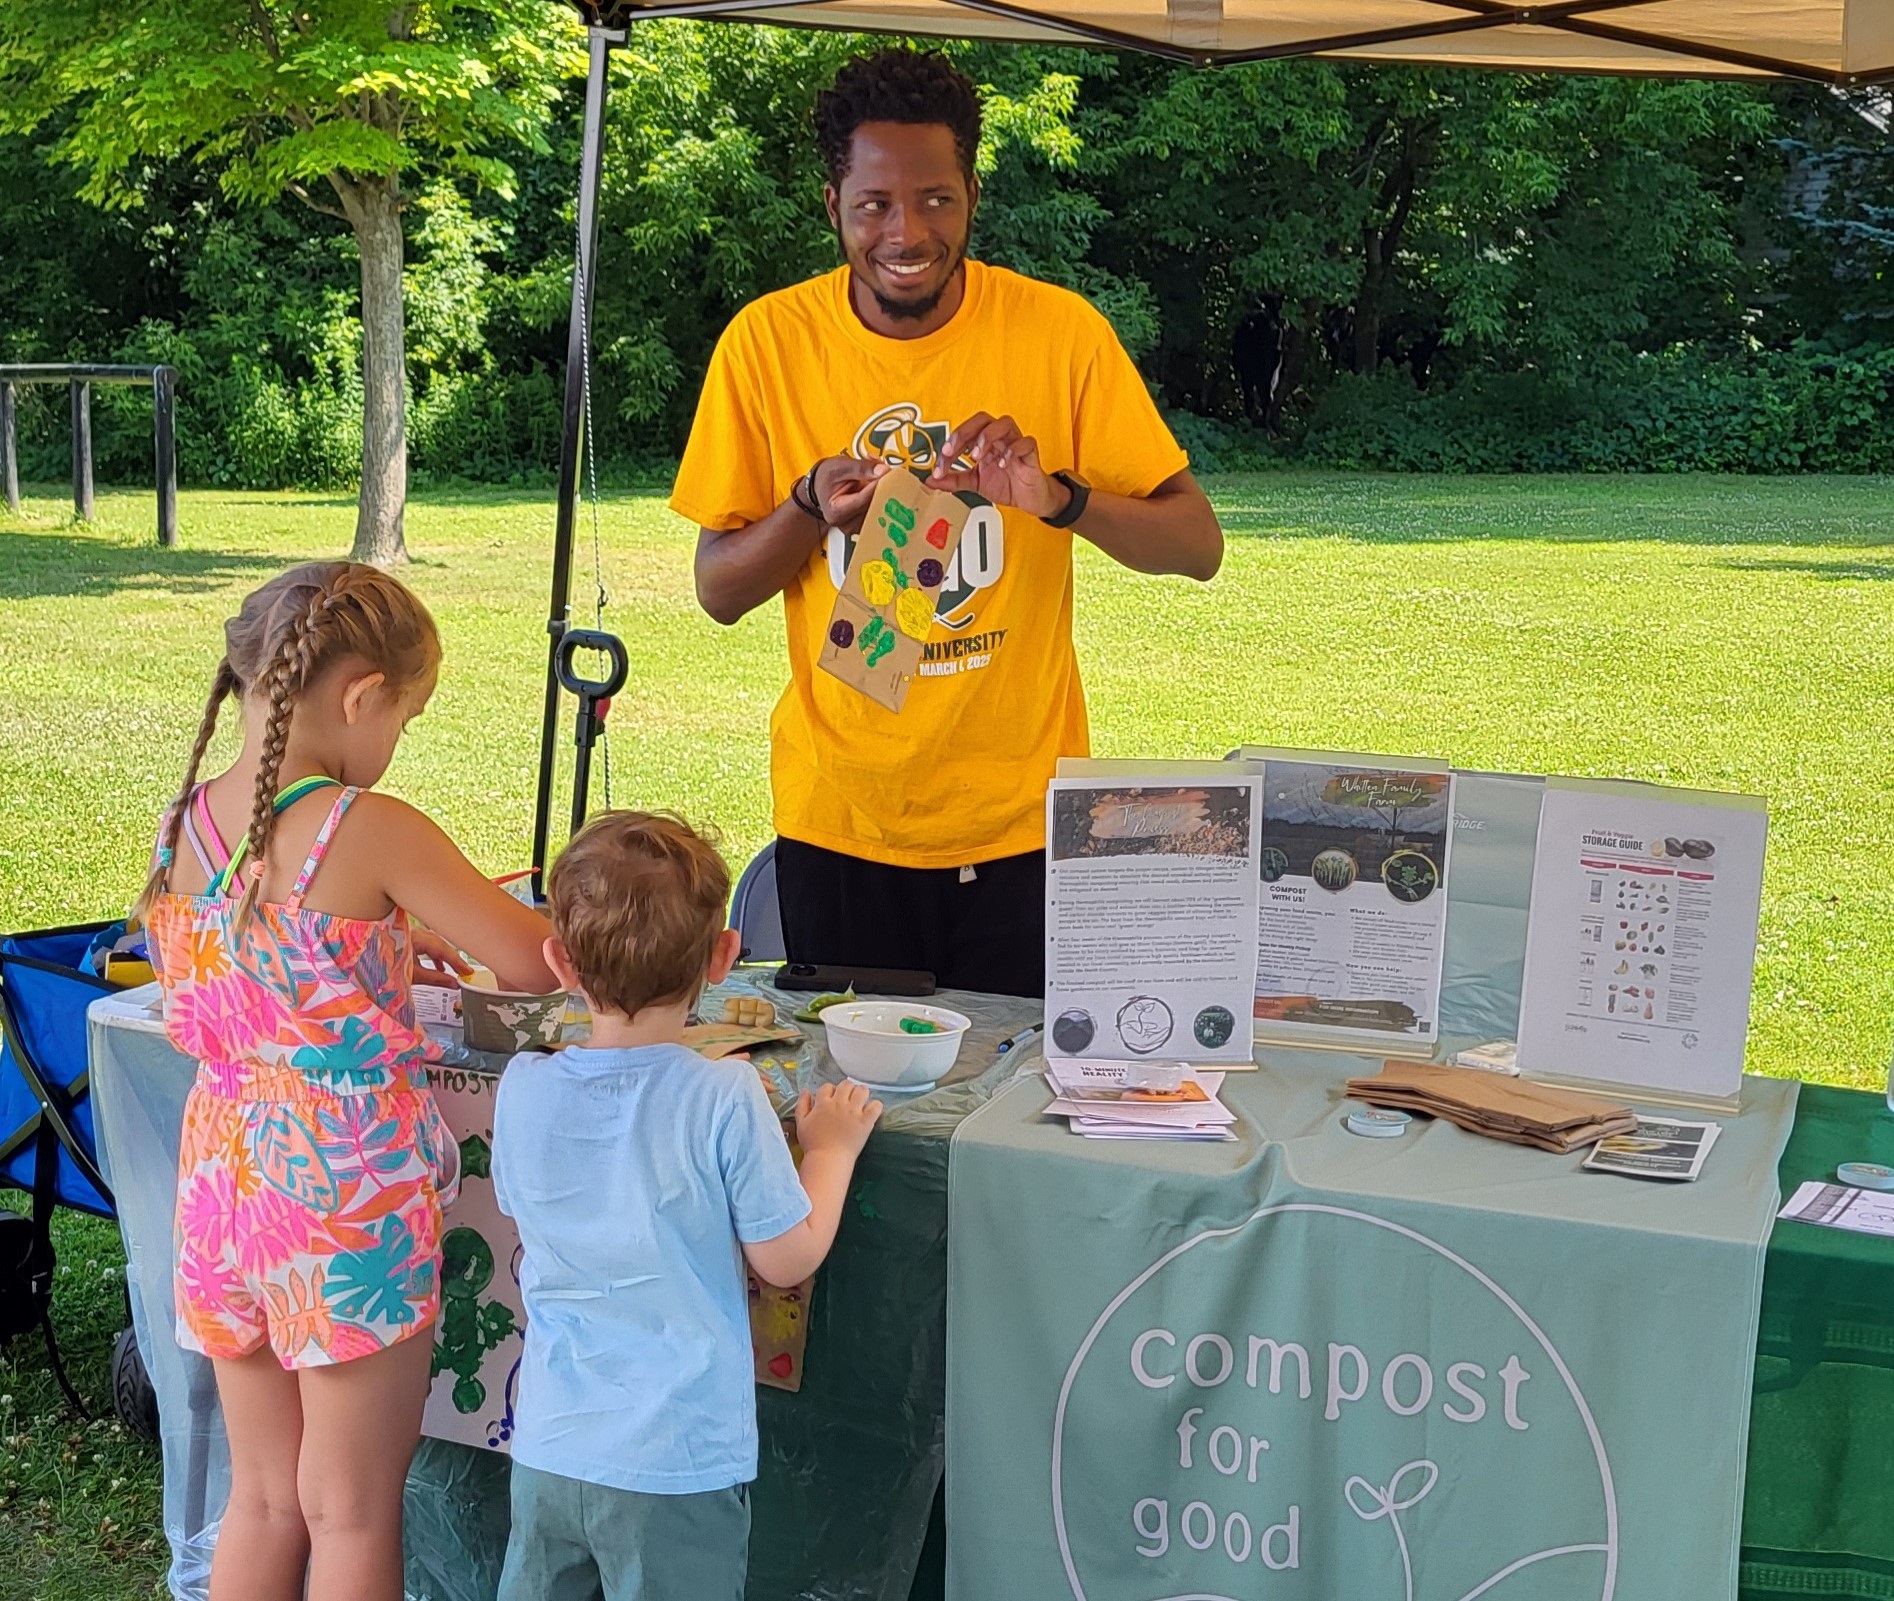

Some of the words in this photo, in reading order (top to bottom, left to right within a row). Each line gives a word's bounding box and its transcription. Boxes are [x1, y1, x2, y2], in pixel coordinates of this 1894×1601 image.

[919, 628, 1008, 660] NIVERSITY
[919, 661, 957, 676] MARCH
[1367, 791, 1396, 809] Farm
[1581, 835, 1618, 848] STORAGE
[1619, 839, 1644, 851] GUIDE
[1269, 885, 1308, 895] COMPOST
[1271, 893, 1291, 902] WITH
[1292, 895, 1306, 903] US!
[425, 1068, 500, 1097] MPOST
[1130, 1328, 1531, 1431] compost
[1176, 1407, 1270, 1483] for
[1133, 1497, 1300, 1570] good
